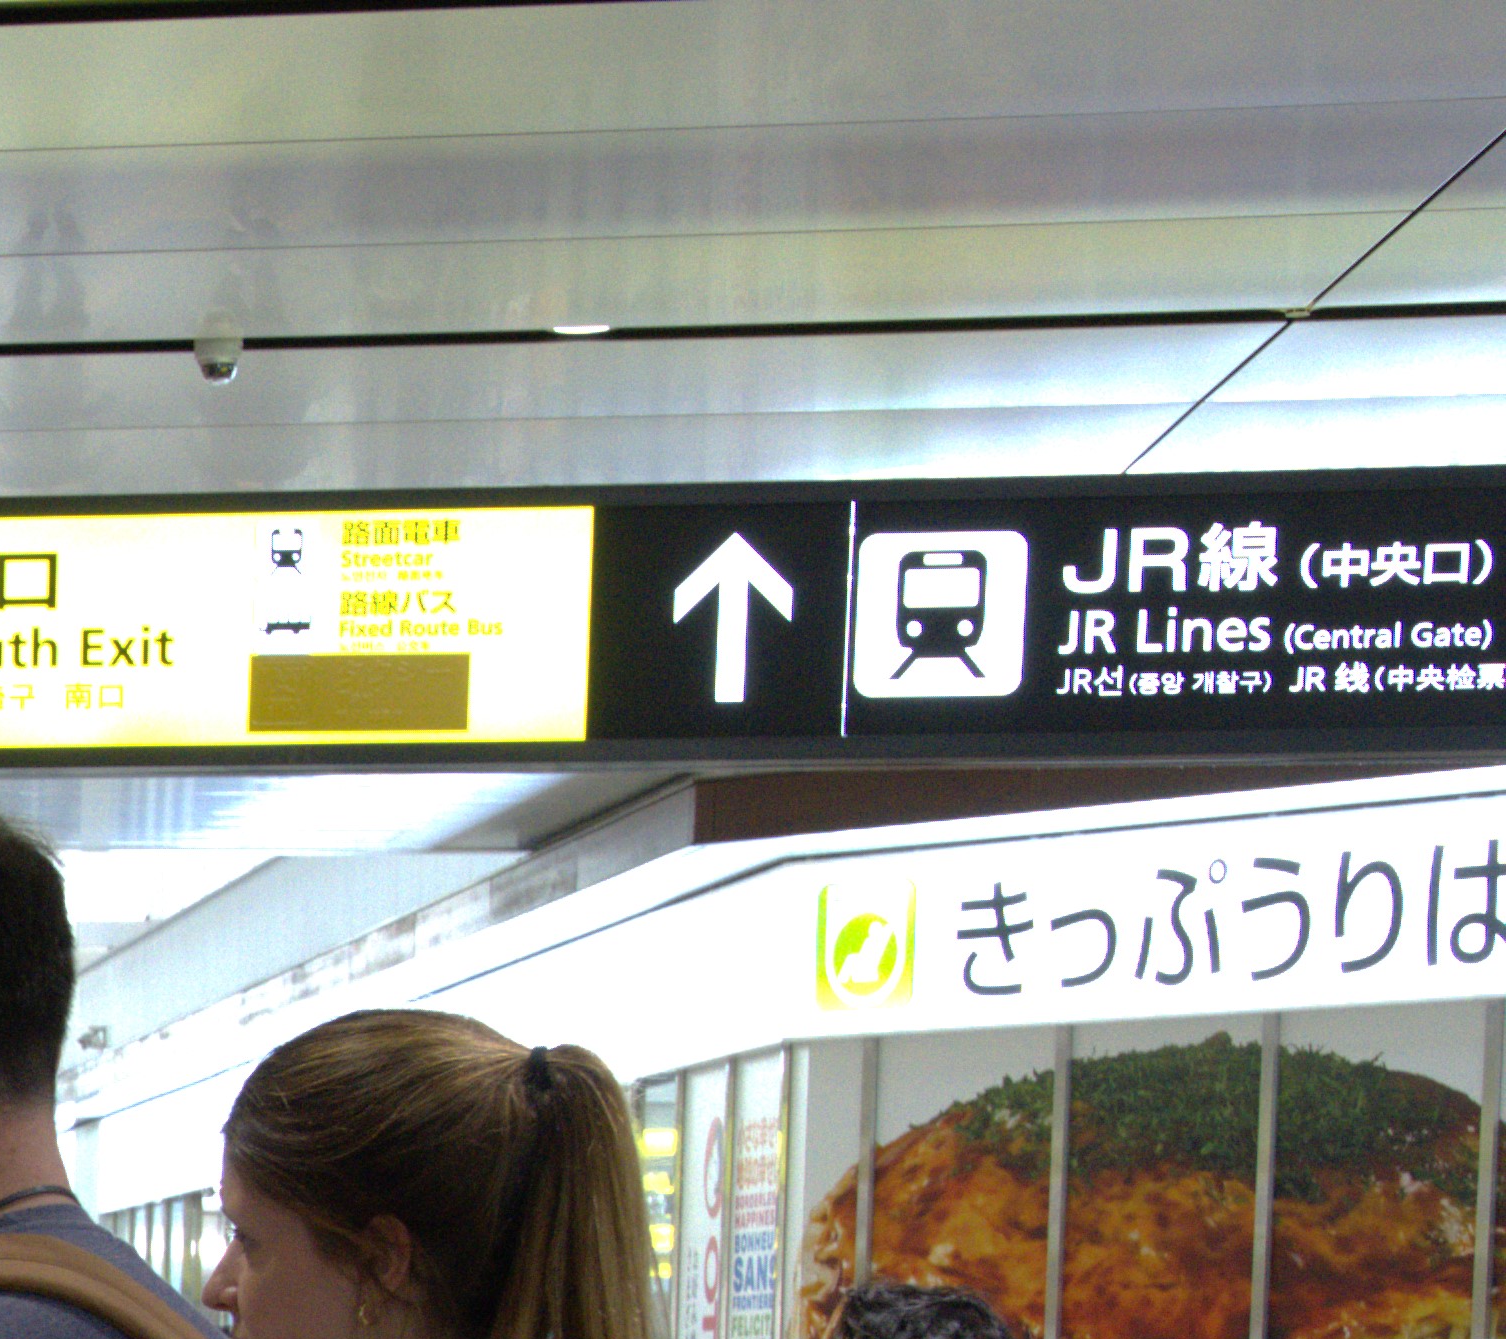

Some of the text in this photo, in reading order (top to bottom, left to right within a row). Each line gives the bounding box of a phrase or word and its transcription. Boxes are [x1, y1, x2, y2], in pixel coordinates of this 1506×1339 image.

[341, 519, 461, 546] 路面電車
[341, 550, 433, 568] Streetcar
[1062, 520, 1495, 595] JR線 (中央口)
[339, 590, 456, 617] 路線バス
[339, 617, 503, 638] Fixed Route Bus
[1057, 606, 1494, 655] JR Lines (Central Gate)
[81, 628, 174, 667] Exit
[1289, 665, 1326, 693] JR
[65, 682, 125, 711] 南口
